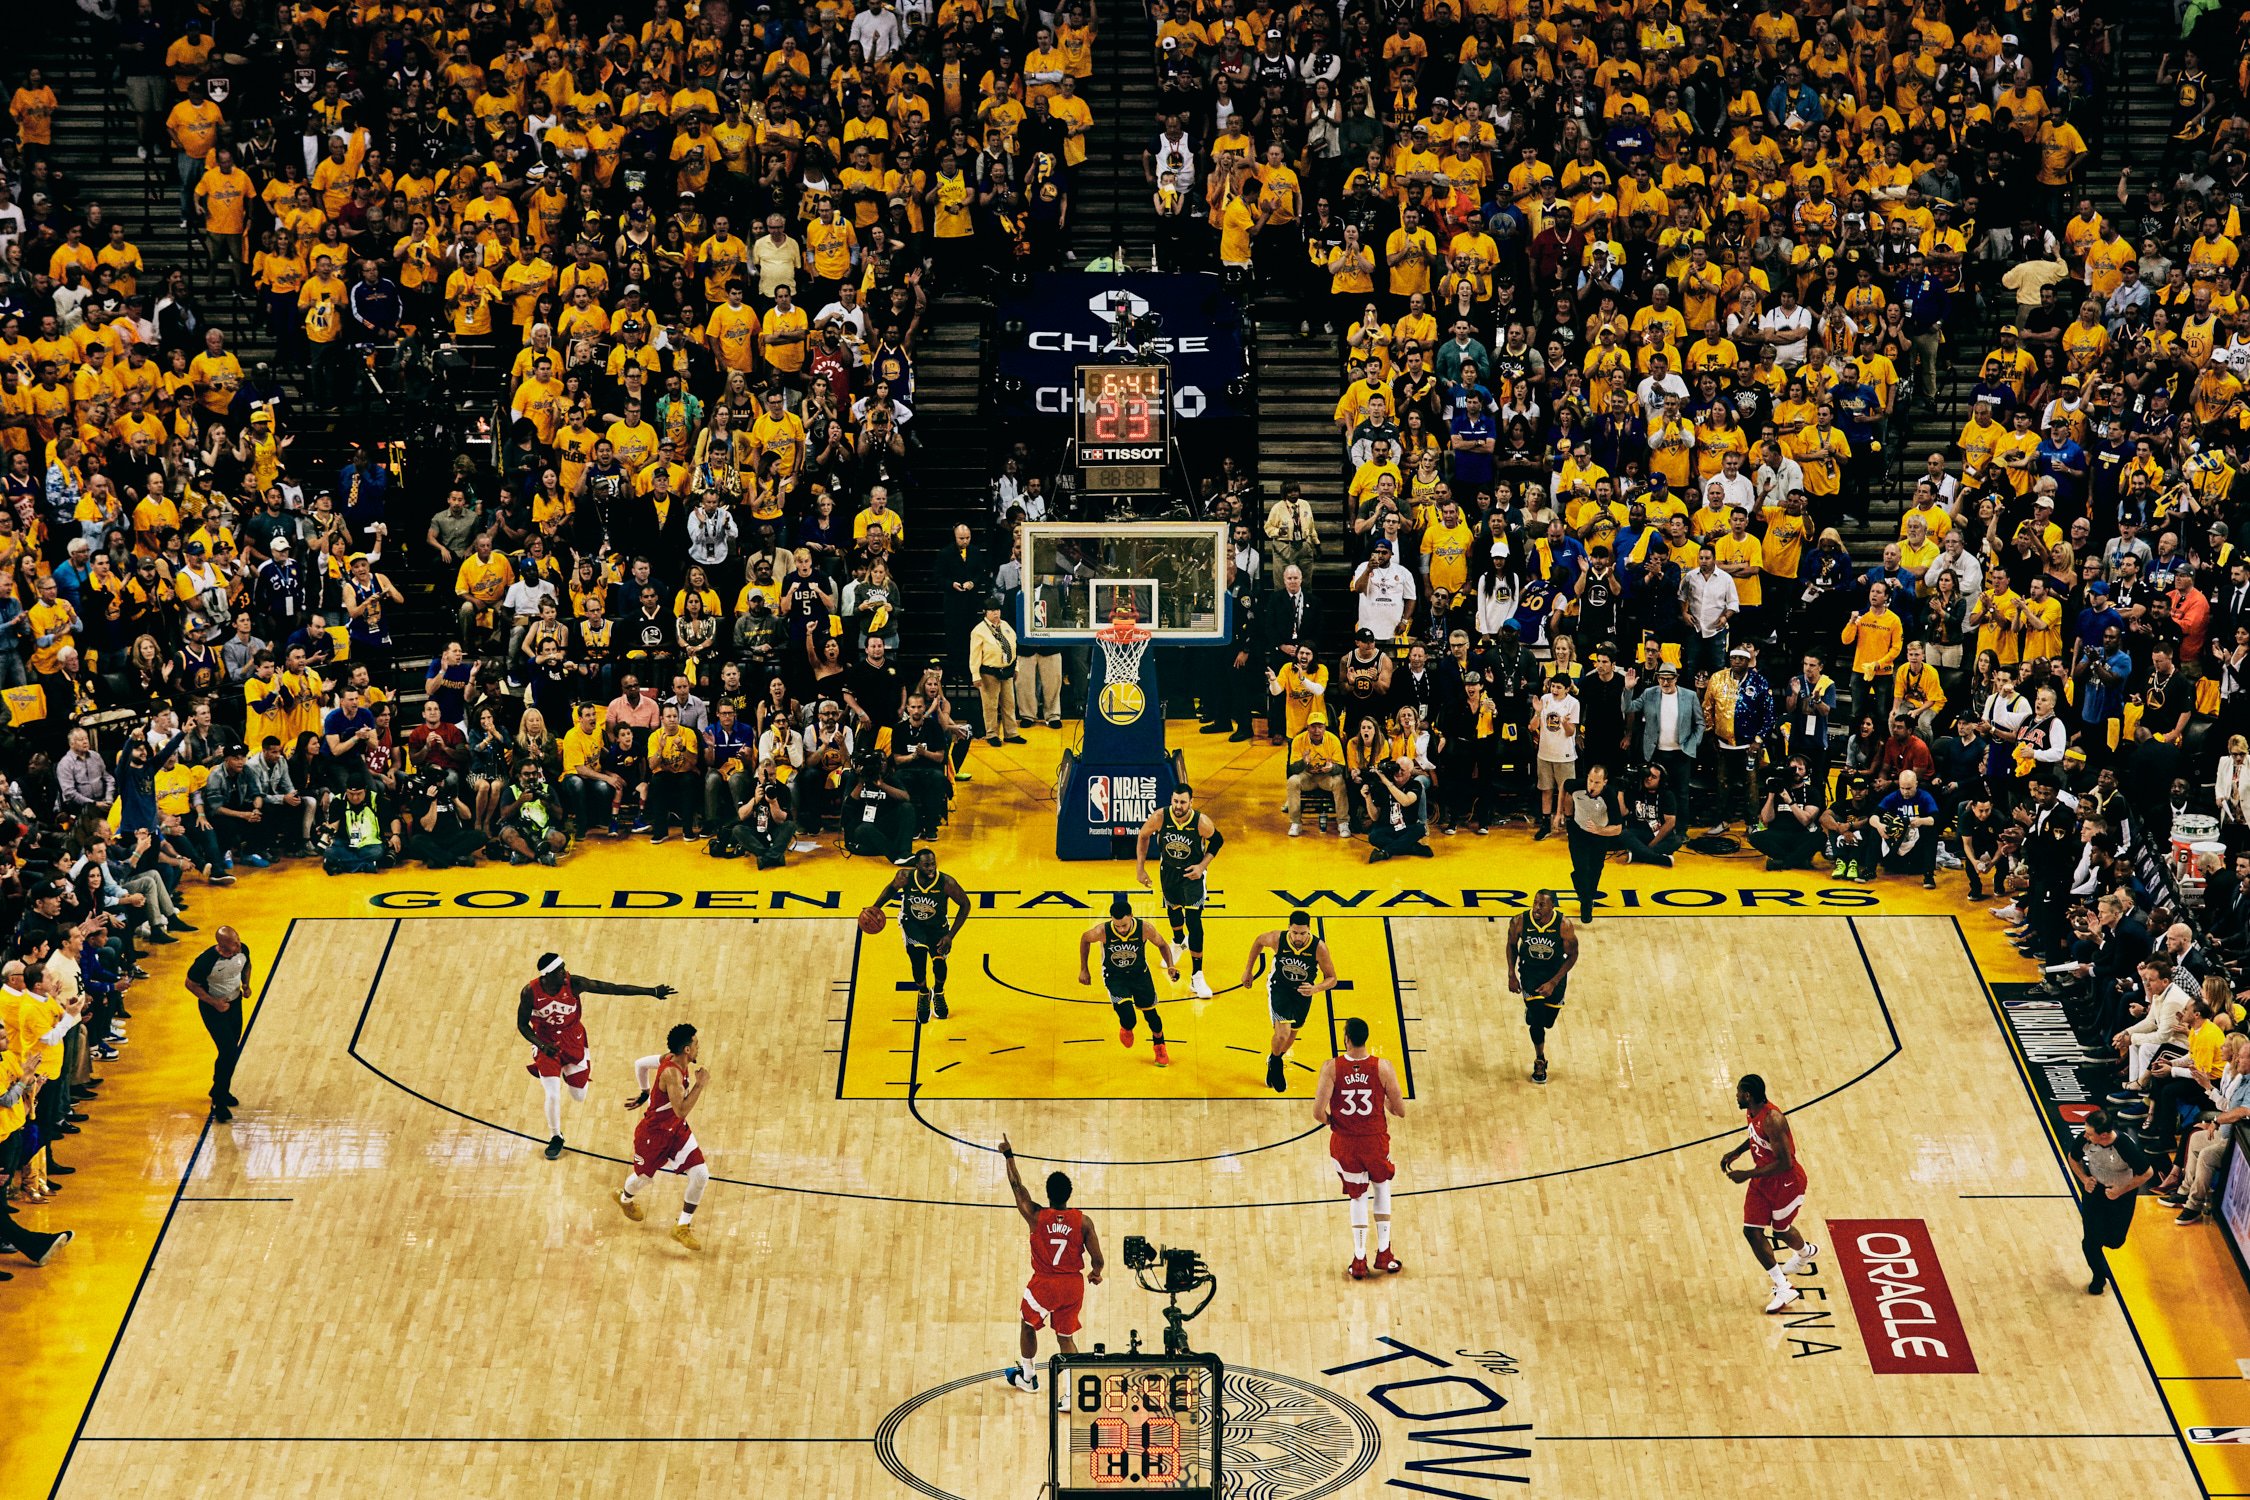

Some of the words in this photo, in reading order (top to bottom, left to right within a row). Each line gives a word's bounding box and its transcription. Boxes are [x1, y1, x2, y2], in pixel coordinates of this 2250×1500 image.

[430, 148, 436, 158] 7
[2183, 244, 2192, 252] 23
[1028, 331, 1209, 353] CHASE
[2235, 356, 2244, 364] 30
[1734, 390, 1758, 402] TOWN
[1096, 399, 1150, 438] 23
[568, 440, 582, 450] WE
[1104, 448, 1164, 460] TISSOT
[794, 590, 818, 600] USA
[866, 589, 890, 598] TOWN
[802, 600, 812, 616] 5
[1521, 594, 1544, 611] 30
[1860, 622, 1891, 632] WARRIORS
[1357, 680, 1370, 690] 23
[370, 757, 384, 770] 43
[860, 788, 886, 800] ESPN
[1113, 776, 1140, 799] NBA
[1140, 776, 1156, 800] 2019
[1113, 800, 1156, 822] FINALS
[1089, 827, 1106, 835] Presented
[1163, 833, 1193, 846] TOWN
[368, 890, 843, 910] GOLDEN
[908, 896, 938, 908] TOWN
[918, 912, 928, 920] 23
[1525, 936, 1556, 948] TOWN
[1108, 944, 1140, 954] TOWN
[1280, 956, 1310, 971] TOWN
[546, 1014, 565, 1025] 43
[2016, 1030, 2084, 1062] FINALS
[1344, 1073, 1369, 1085] GASOL
[1340, 1089, 1373, 1116] 33
[1752, 1144, 1763, 1158] 2
[1046, 1222, 1072, 1236] LOWRY
[1050, 1238, 1068, 1266] 7
[1856, 1232, 1948, 1358] ORACLE
[1456, 1349, 1520, 1376] The
[1321, 1336, 1533, 1500] TOW
[1090, 1417, 1181, 1483] 23
